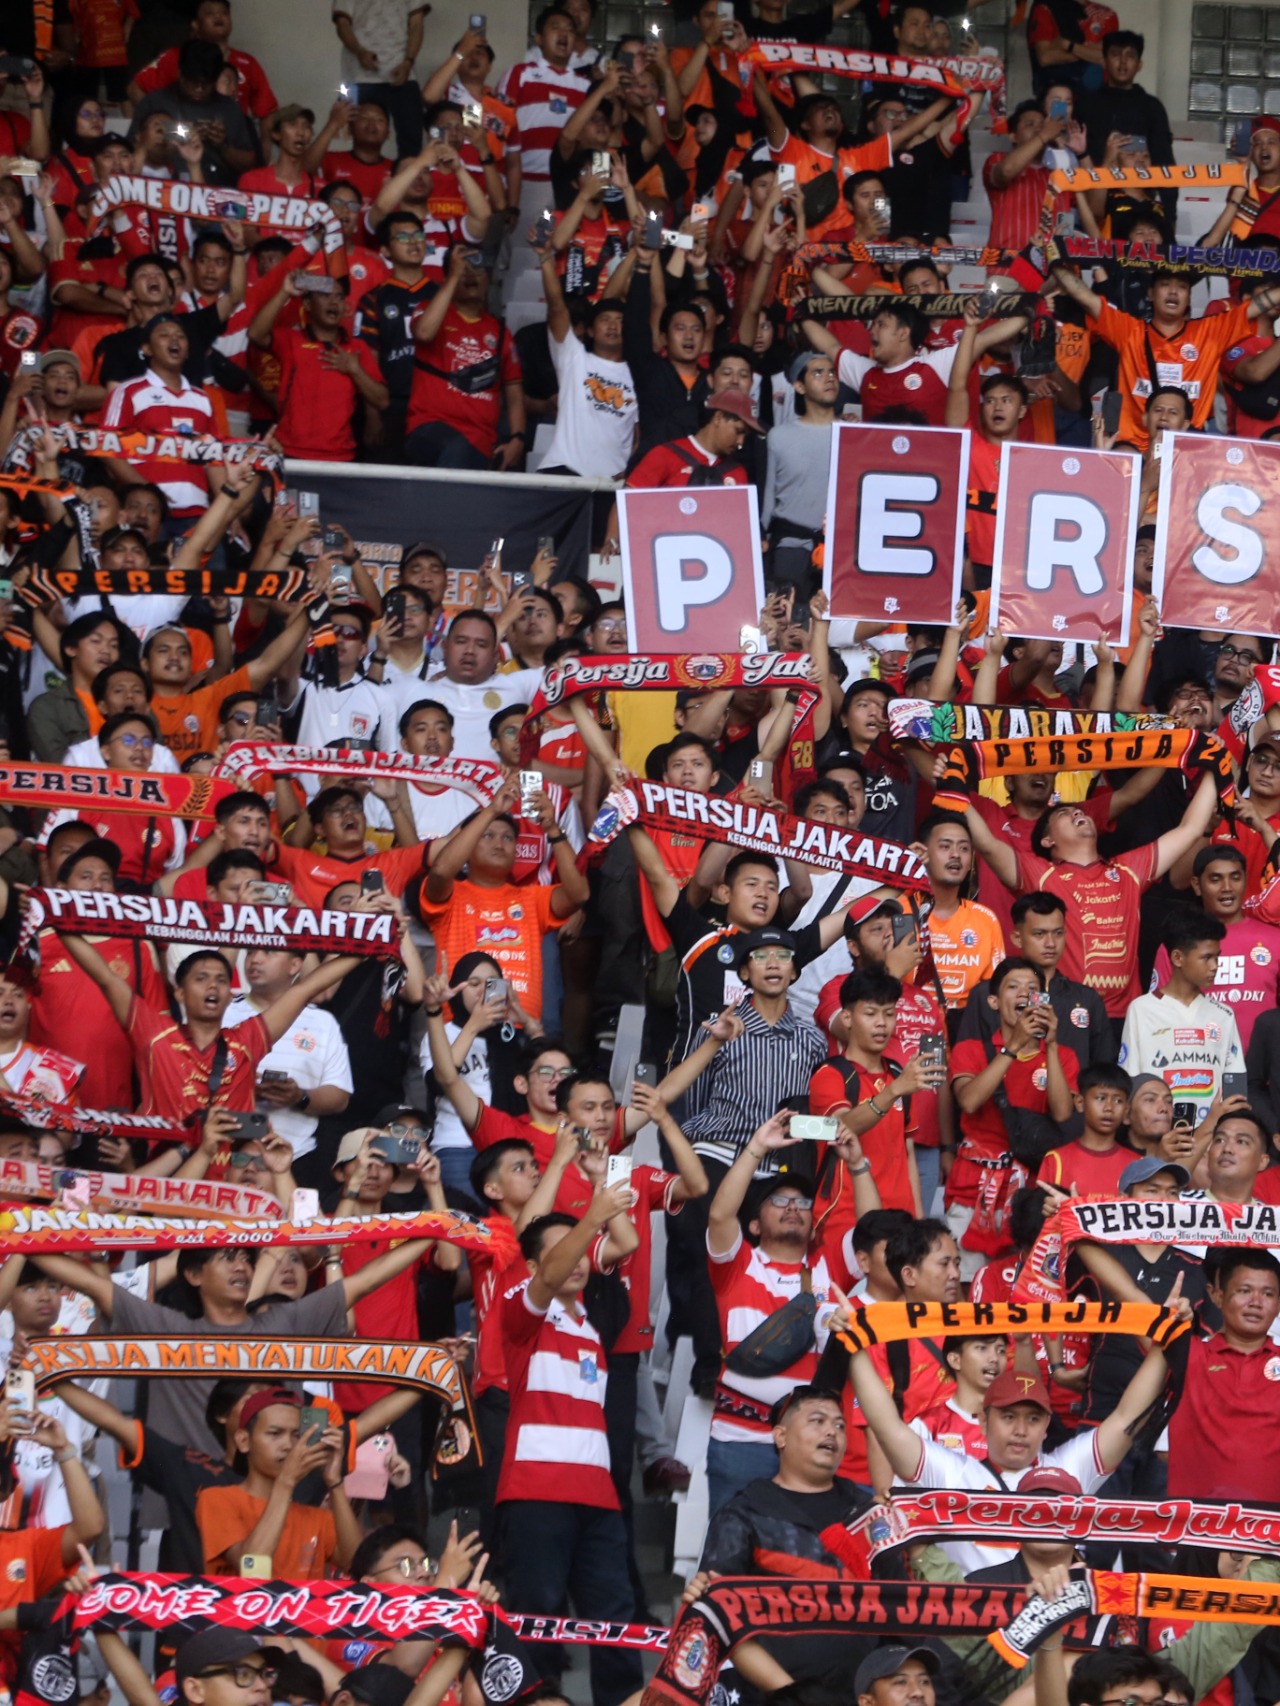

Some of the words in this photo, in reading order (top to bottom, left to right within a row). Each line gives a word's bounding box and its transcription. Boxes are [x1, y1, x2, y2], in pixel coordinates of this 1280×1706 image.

[758, 43, 945, 84] PERSIJA
[1064, 236, 1165, 262] MENTAL
[856, 471, 941, 577] E
[1025, 490, 1109, 597] R
[1190, 482, 1265, 586] S
[61, 570, 280, 596] PERSIJA
[652, 531, 736, 634] P
[995, 733, 1175, 768] PERSIJA
[379, 752, 505, 794] JAKARTA
[640, 780, 782, 844] PERSIJA
[726, 830, 801, 861] KEBANGGAAN
[796, 847, 845, 872] JAKARTA
[43, 887, 208, 930] PERSIJA
[219, 903, 394, 944] JAKARTA
[144, 922, 231, 945] KEBANGGAAN
[232, 931, 288, 948] JAKARTA
[1242, 991, 1266, 1002] DKI
[1171, 1051, 1222, 1066] AMMAN
[110, 1175, 286, 1220] JAKARTA
[1074, 1201, 1225, 1234] PERSIJA
[226, 1231, 275, 1245] 2000
[906, 1302, 1122, 1328] PERSIJA
[157, 1341, 418, 1373] MENYATUKAN
[917, 1490, 1144, 1541] Persija
[77, 1580, 221, 1620] COME
[233, 1587, 314, 1624] ON
[327, 1591, 487, 1635] TIGER
[720, 1584, 883, 1633] PERSIJA
